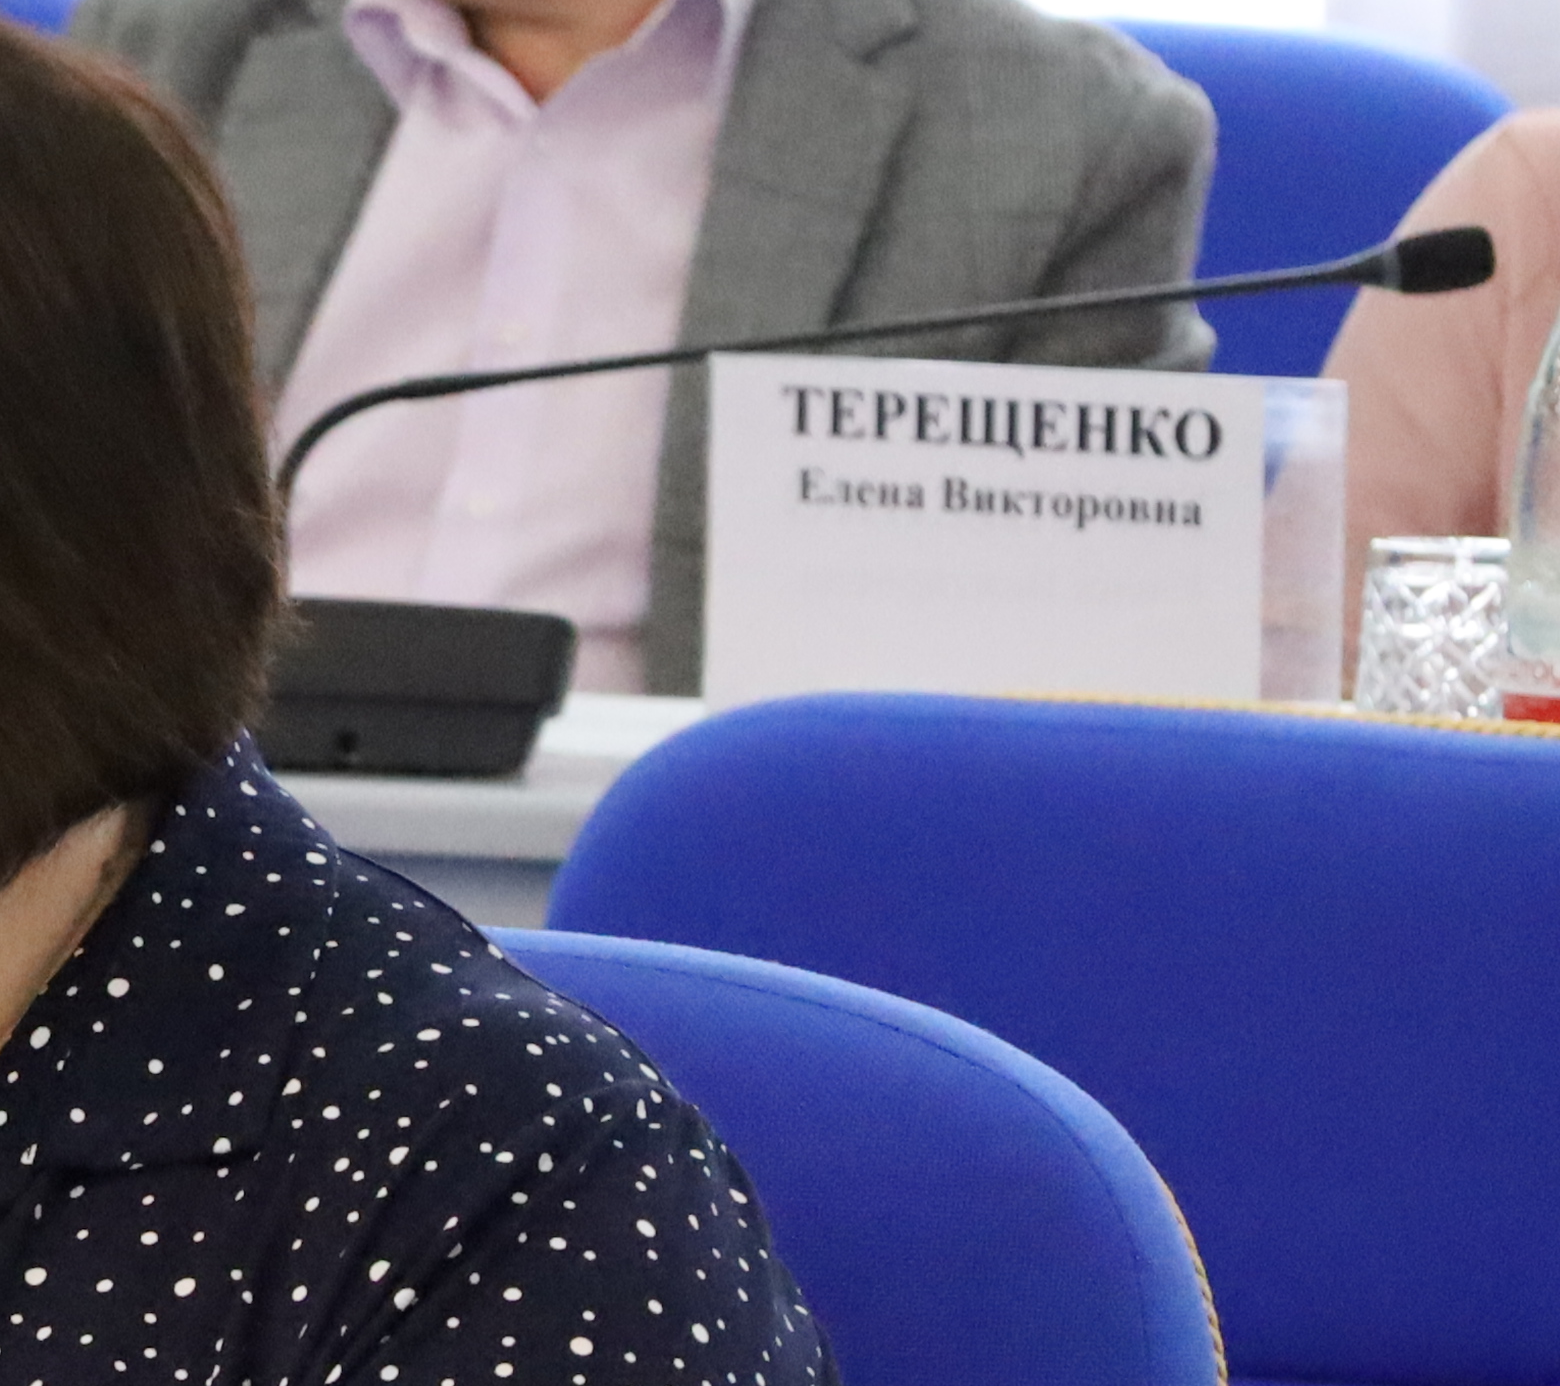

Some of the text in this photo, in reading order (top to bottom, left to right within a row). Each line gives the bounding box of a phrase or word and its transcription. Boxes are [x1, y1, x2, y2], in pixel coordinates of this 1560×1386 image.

[782, 385, 1224, 462] ТЕРЕЩЕНКО
[799, 467, 1203, 531] Елена Викторовна
